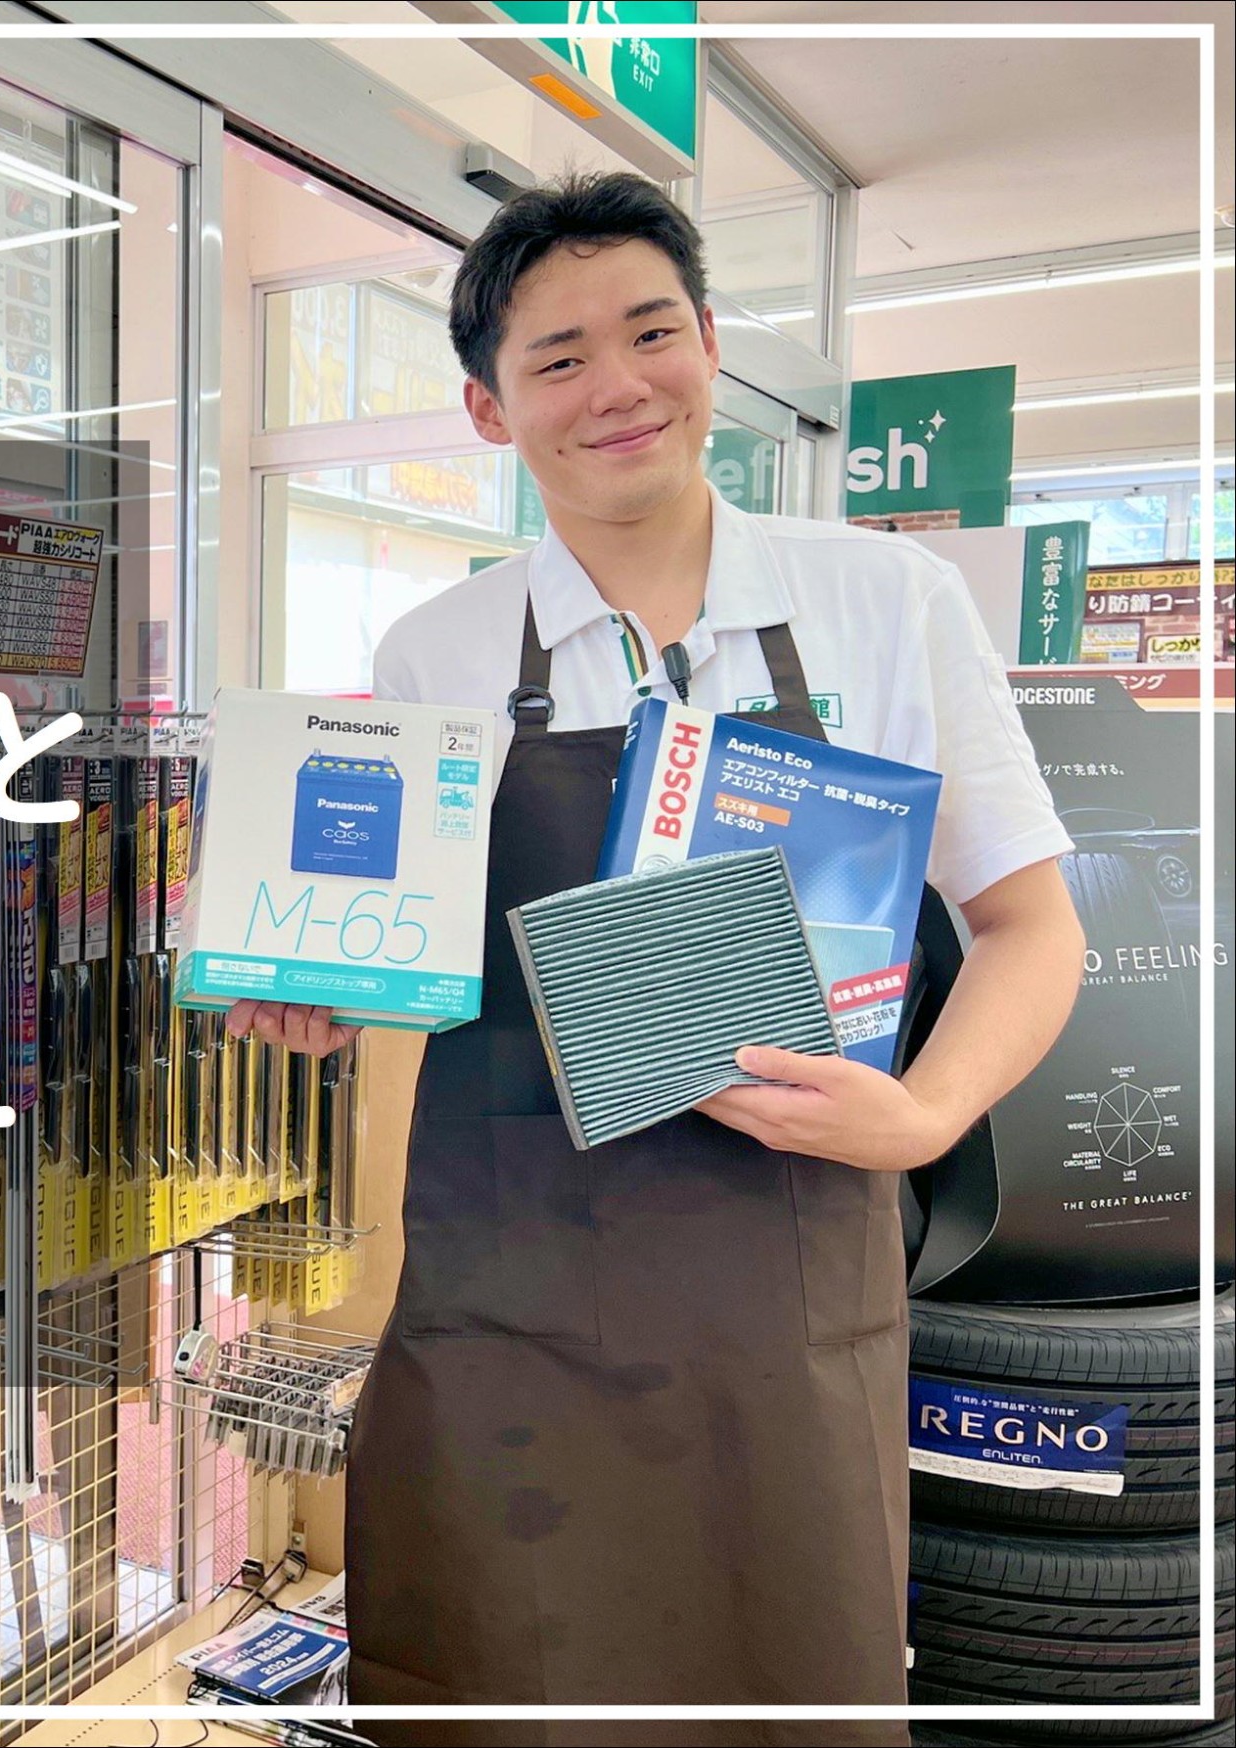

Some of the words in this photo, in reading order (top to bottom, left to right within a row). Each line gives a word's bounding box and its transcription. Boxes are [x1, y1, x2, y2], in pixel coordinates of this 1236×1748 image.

[633, 64, 654, 92] EXIT
[21, 523, 53, 539] PIAA
[33, 540, 96, 561] 超強力シリコート
[1038, 536, 1064, 664] 豊富なサー
[306, 714, 401, 738] Panasonic
[726, 737, 782, 763] Aeristo
[784, 751, 813, 770] Eco
[653, 722, 702, 840] BOSCH
[720, 772, 775, 794] アエリスト
[777, 786, 800, 802] エコ
[723, 758, 820, 791] エアコンフィルター
[824, 783, 911, 817] 抗菌・脱臭タイプ
[317, 798, 379, 814] Panasonic
[717, 796, 759, 817] スズキ用
[715, 811, 765, 834] AE-S03
[244, 880, 435, 966] M-65
[1081, 976, 1114, 986] GREAT
[1120, 973, 1169, 984] BALANCE
[1111, 1066, 1136, 1075] SILENCE
[1066, 1092, 1098, 1101] HANDLING
[1067, 1122, 1092, 1130] WEIGHT
[1123, 1170, 1137, 1178] LIFE
[1063, 1202, 1084, 1211] THE
[1090, 1198, 1127, 1209] GREAT
[1134, 1191, 1189, 1204] BALANCE
[920, 1404, 1109, 1452] REGNO
[982, 1448, 1042, 1464] ENLITEN
